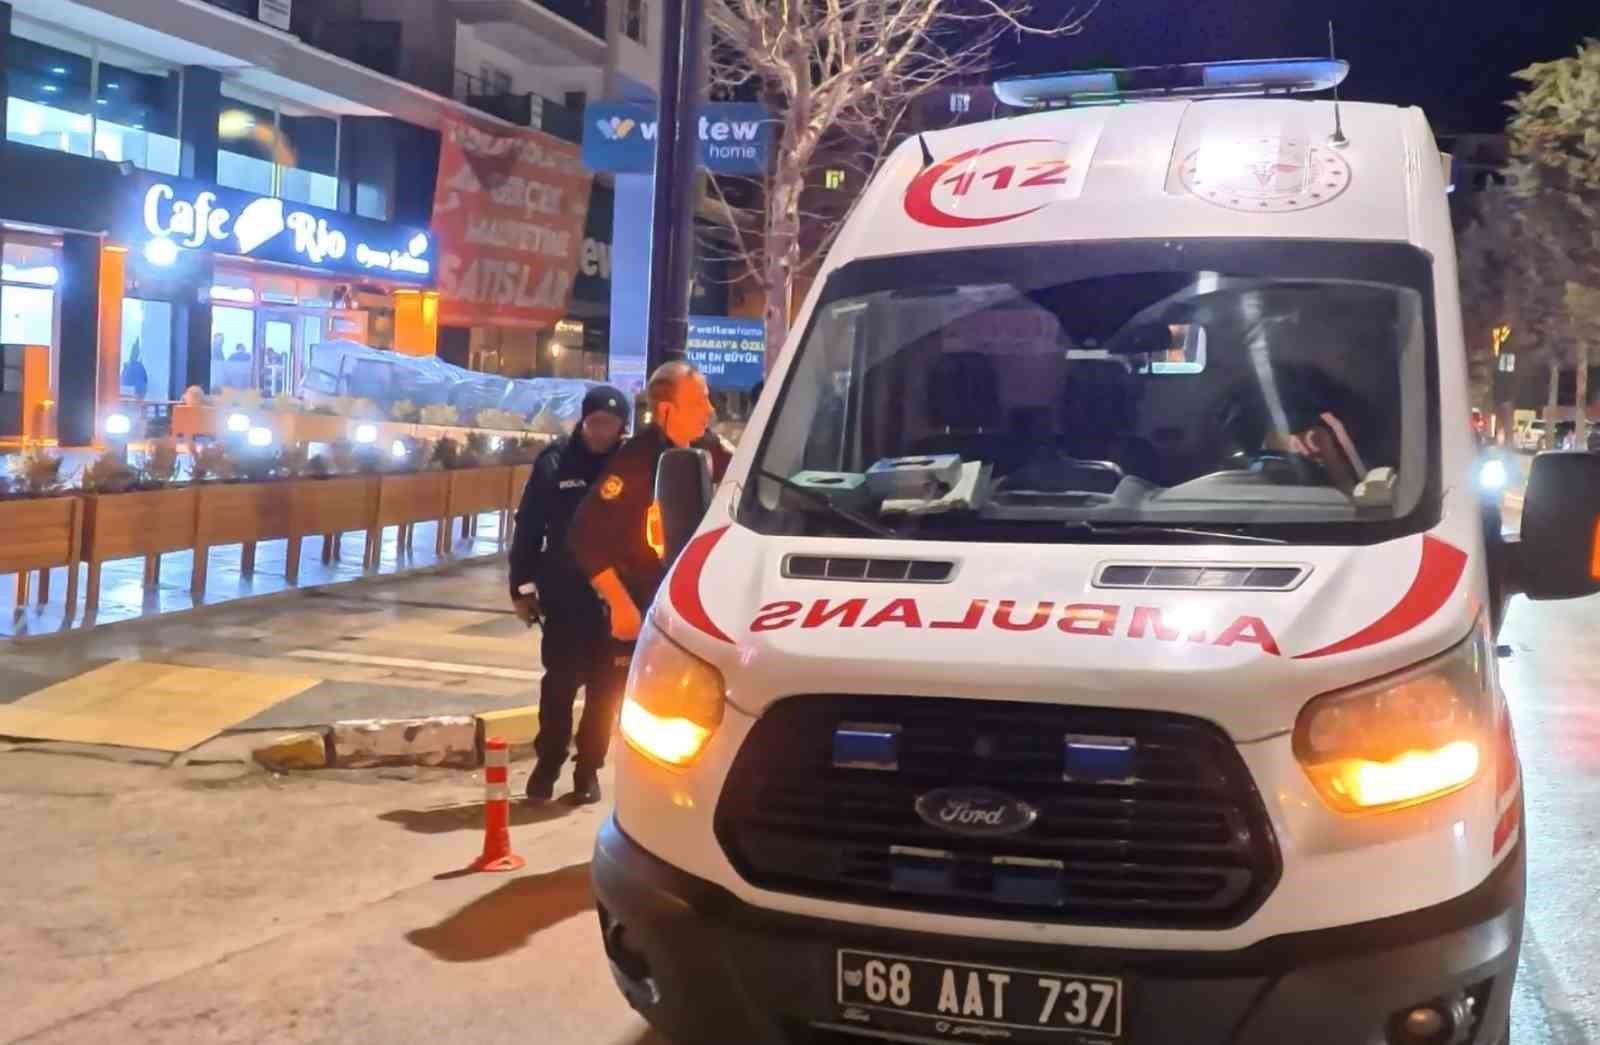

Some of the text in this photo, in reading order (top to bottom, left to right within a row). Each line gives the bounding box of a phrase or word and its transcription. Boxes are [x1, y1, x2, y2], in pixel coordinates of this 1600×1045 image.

[709, 144, 757, 159] home
[943, 160, 1071, 196] 112
[144, 183, 231, 248] Cafe
[287, 210, 347, 264] Rio
[940, 799, 1007, 825] Ford
[865, 959, 1114, 1028] 68 AAT 737
